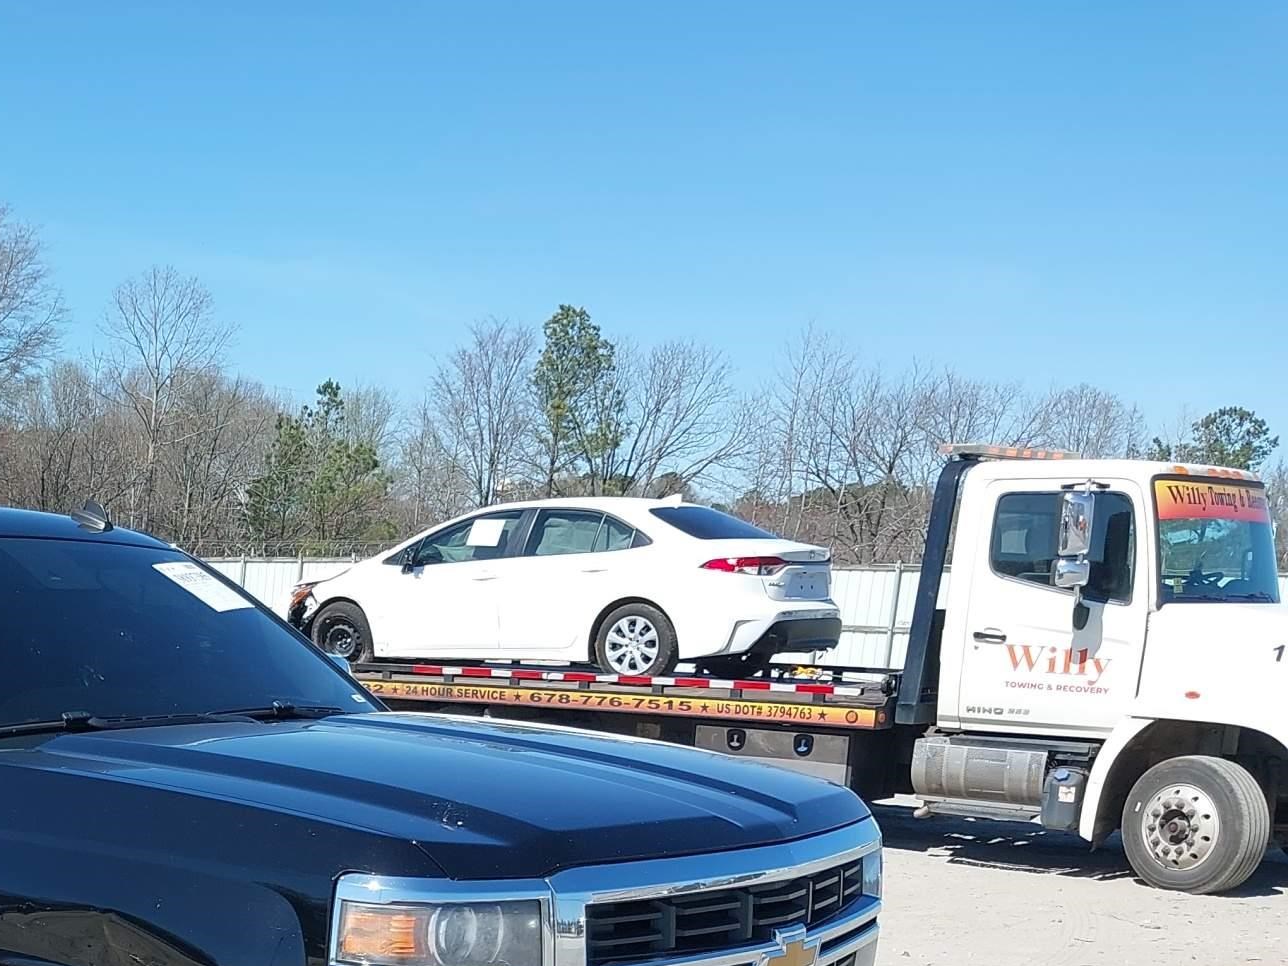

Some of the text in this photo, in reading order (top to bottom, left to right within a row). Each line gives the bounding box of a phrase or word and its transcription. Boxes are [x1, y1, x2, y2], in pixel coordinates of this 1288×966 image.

[1167, 485, 1208, 511] Willy
[1208, 486, 1238, 512] Towing
[1006, 644, 1112, 685] Willy
[1005, 680, 1044, 690] TOWING
[1056, 684, 1109, 695] RECOVERY
[405, 685, 418, 696] 24
[421, 687, 453, 698] HOUR
[456, 688, 506, 701] SERVICE
[529, 691, 692, 712] 678-776-7515
[716, 703, 731, 714] US
[734, 704, 763, 717] DOT#
[766, 705, 813, 720] 3794763
[966, 705, 1004, 715] HINO
